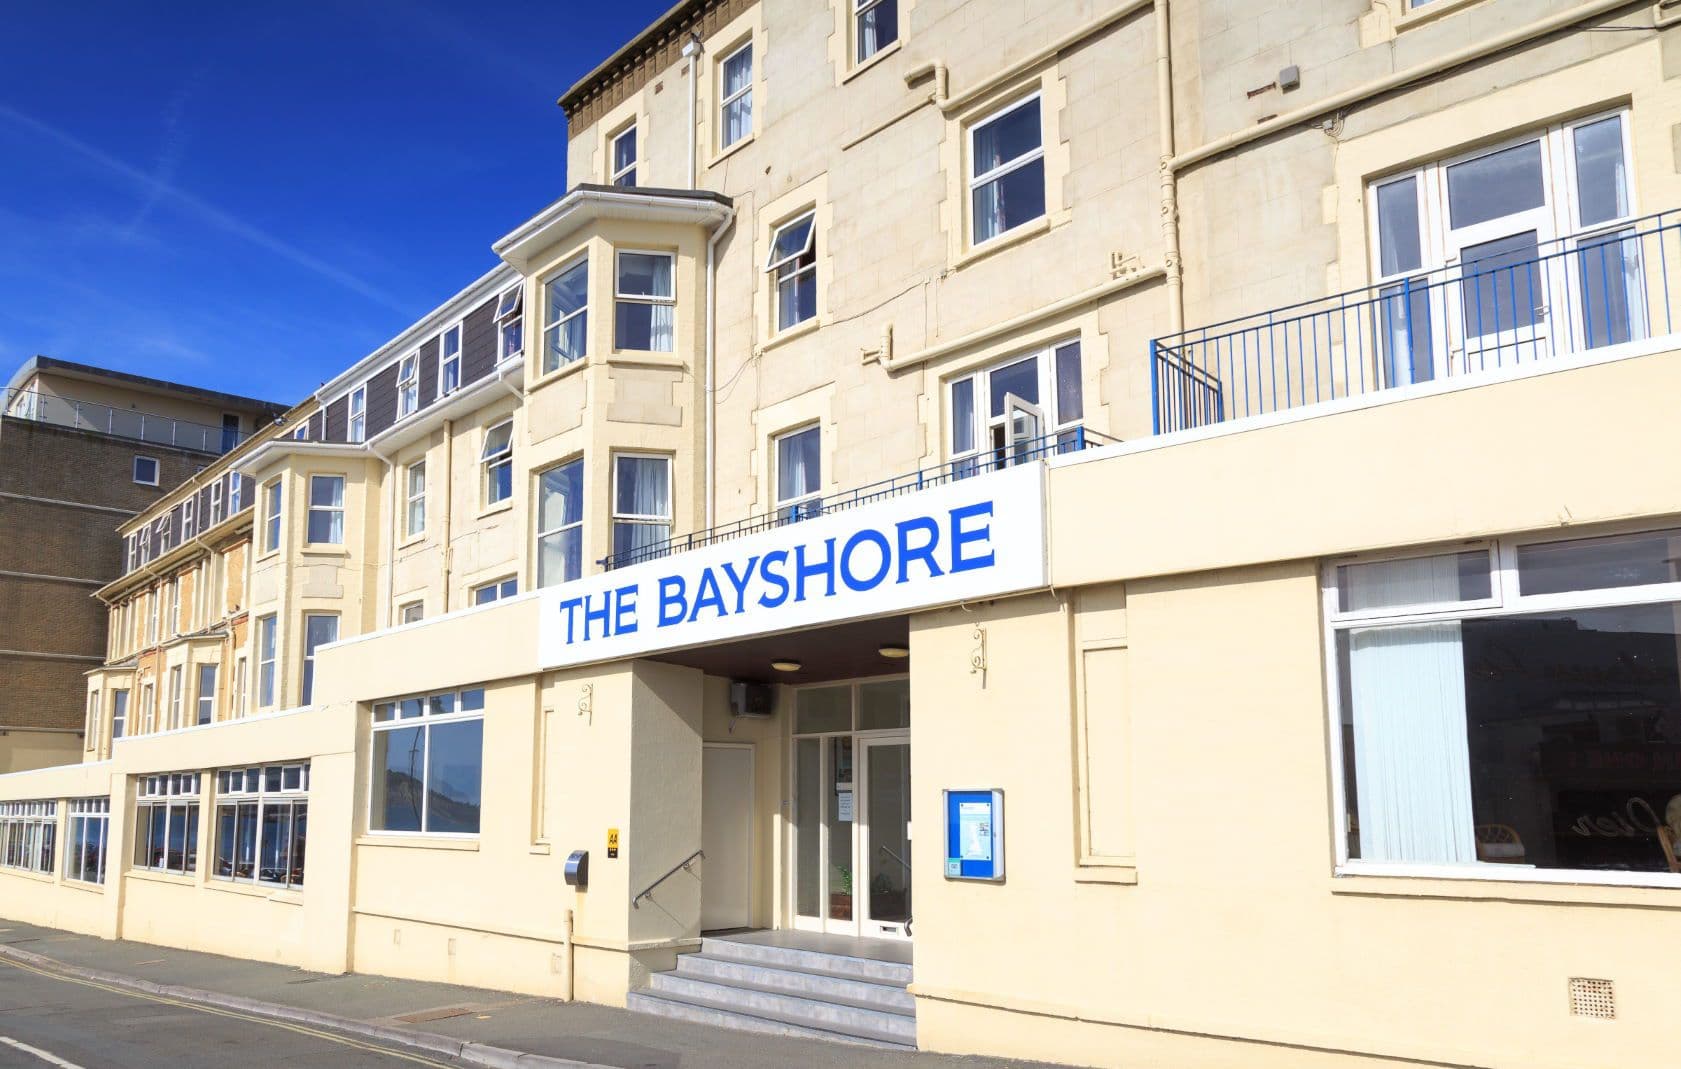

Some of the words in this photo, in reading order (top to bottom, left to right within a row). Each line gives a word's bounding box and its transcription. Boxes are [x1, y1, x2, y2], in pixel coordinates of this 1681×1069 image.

[559, 584, 639, 644] THE
[657, 501, 996, 628] BAYSHORE
[609, 834, 618, 844] AA
